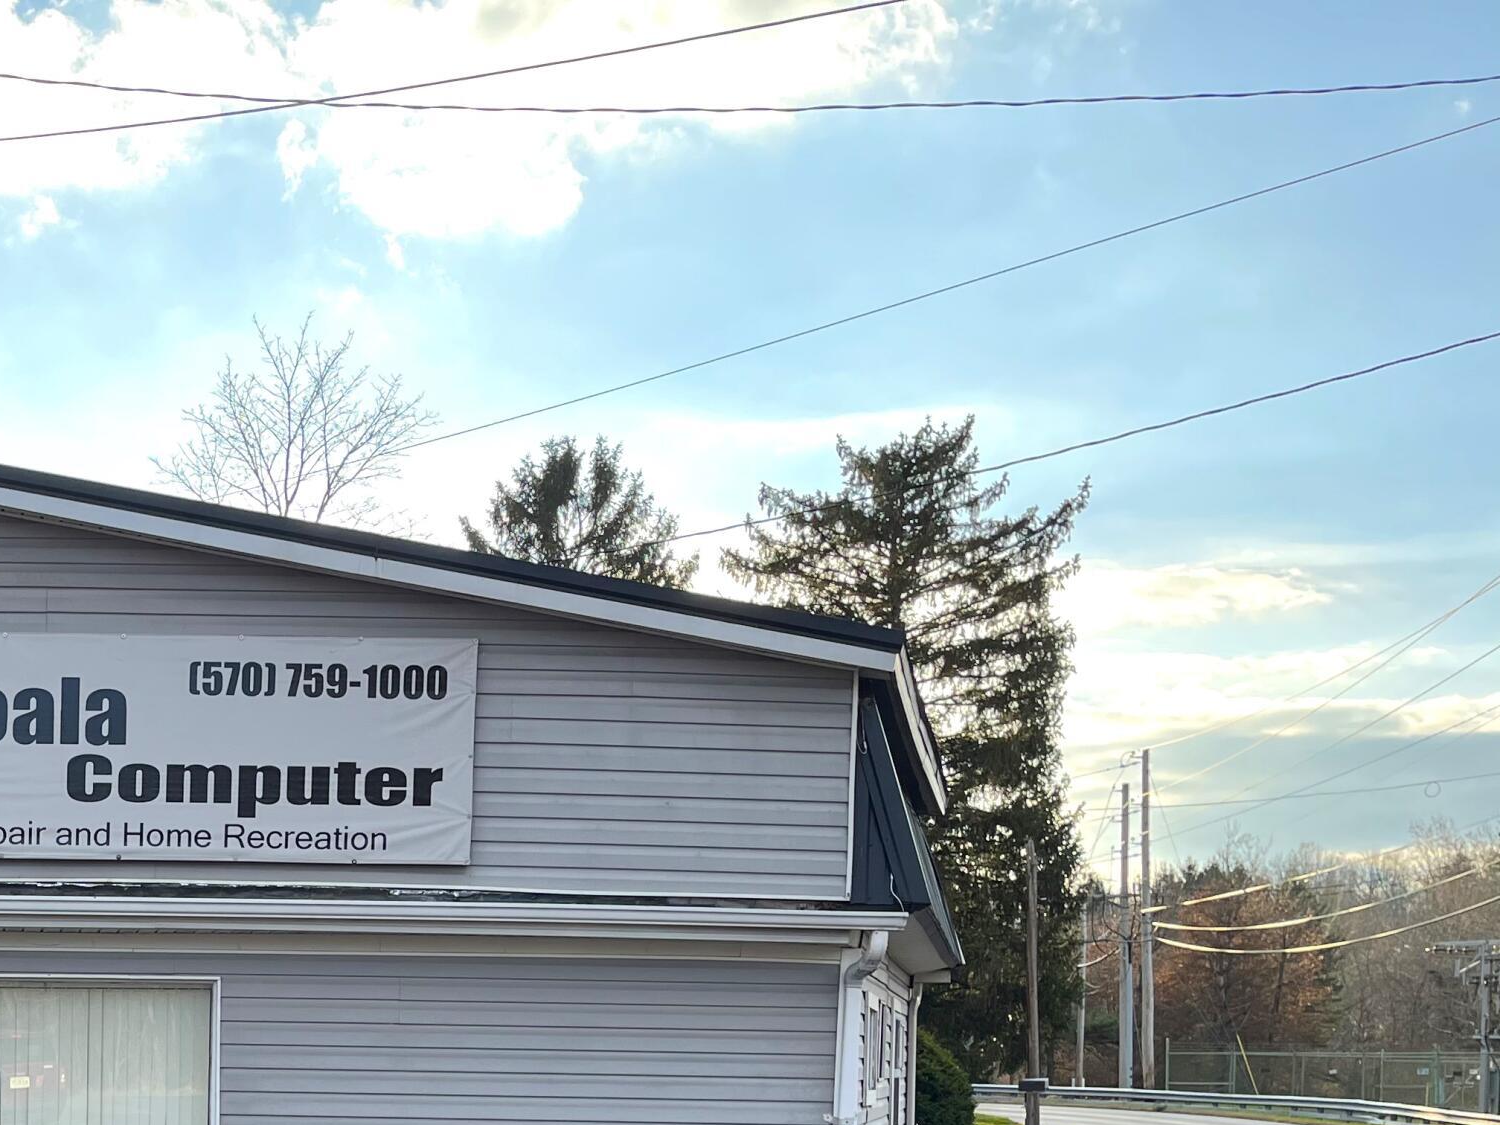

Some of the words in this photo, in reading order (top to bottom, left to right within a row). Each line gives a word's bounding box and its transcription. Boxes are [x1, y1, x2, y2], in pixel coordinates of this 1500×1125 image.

[189, 661, 276, 697] (570)
[285, 663, 449, 701] 759-1000
[66, 753, 444, 819] Computer
[55, 822, 112, 847] and
[123, 822, 212, 848] Home
[223, 823, 388, 851] Recreation
